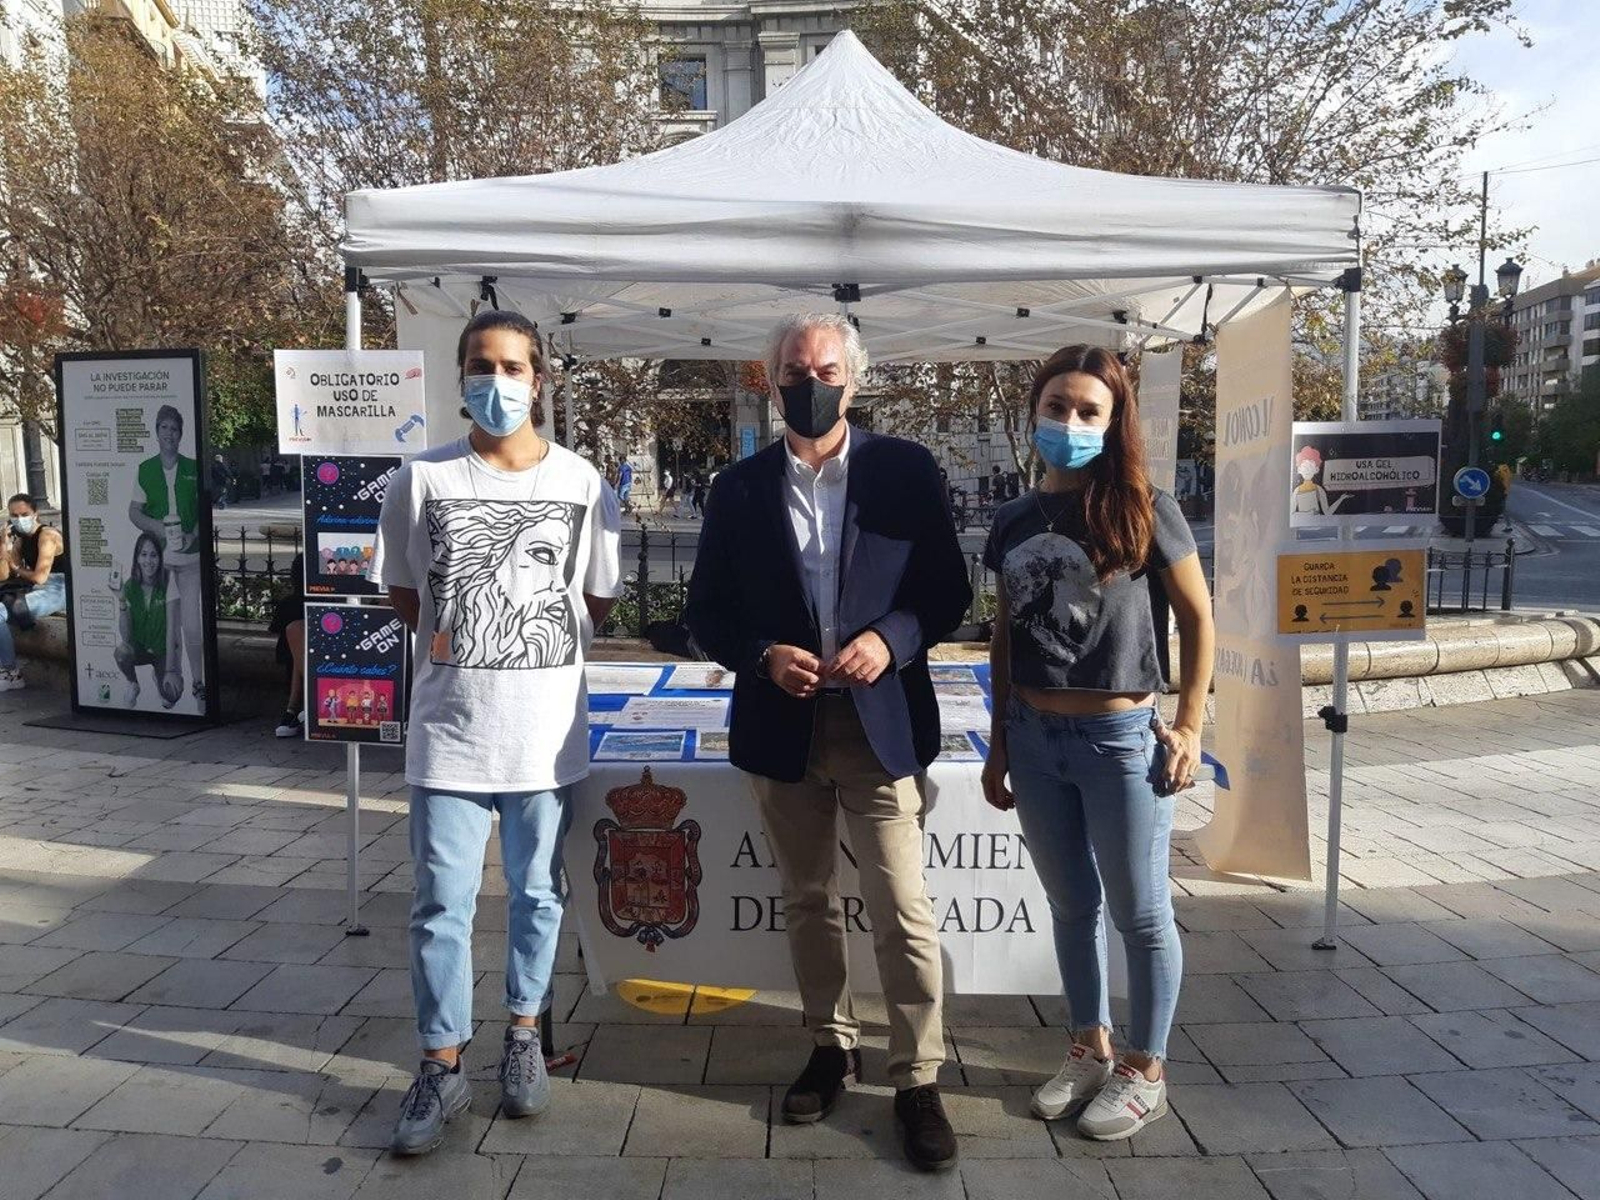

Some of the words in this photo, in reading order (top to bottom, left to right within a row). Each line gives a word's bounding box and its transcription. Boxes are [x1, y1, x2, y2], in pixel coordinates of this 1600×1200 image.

[90, 372, 102, 382] LA
[103, 370, 170, 382] INVESTIGACIÓN
[310, 372, 400, 387] OBLIGATORIO
[93, 383, 106, 393] NO
[108, 383, 137, 392] PUEDE
[139, 382, 168, 392] PARAR
[333, 388, 358, 402] USO
[362, 389, 378, 402] DE
[316, 404, 396, 418] MASCARILLA
[1355, 459, 1374, 469] USA
[1376, 459, 1392, 469] GEL
[1291, 575, 1302, 585] LA
[1302, 574, 1349, 584] DISTANCIA
[1304, 585, 1350, 595] SEGURIDAD
[360, 618, 402, 651] GAME
[376, 634, 400, 654] ON
[729, 895, 788, 932] DE
